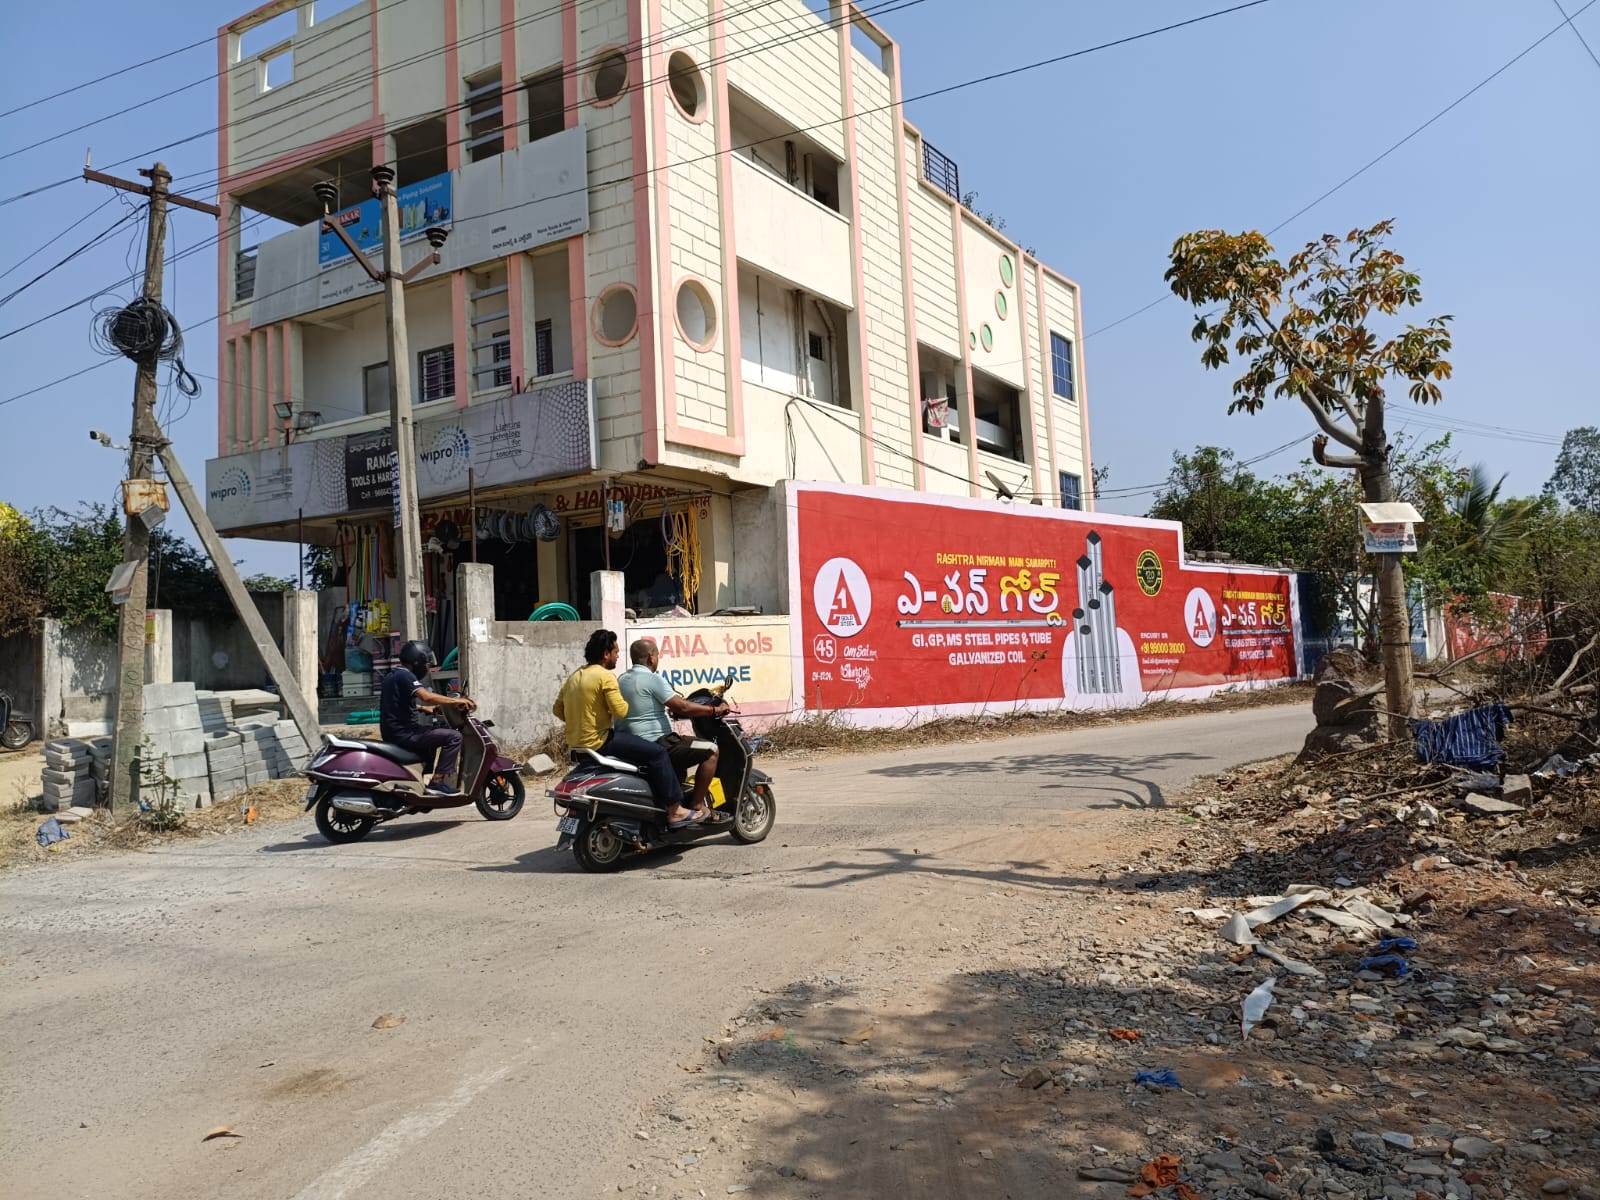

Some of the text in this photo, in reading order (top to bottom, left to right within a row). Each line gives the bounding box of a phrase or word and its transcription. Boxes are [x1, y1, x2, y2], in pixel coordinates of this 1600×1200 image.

[366, 454, 393, 471] RANA
[420, 446, 453, 464] wipro
[351, 474, 371, 488] TOOLS
[210, 485, 237, 501] wipro
[555, 494, 570, 512] &
[936, 552, 975, 566] RASHTRA
[976, 555, 1006, 567] NIRMAN
[1008, 556, 1025, 567] MAIN
[723, 631, 773, 656] tools
[965, 633, 994, 646] STEEL
[995, 632, 1020, 645] PIPES
[1021, 633, 1029, 647] &
[1029, 632, 1052, 645] TUBE
[815, 639, 834, 658] 45
[949, 651, 1026, 666] GALVANIZED COIL
[656, 665, 752, 687] ARDWARE
